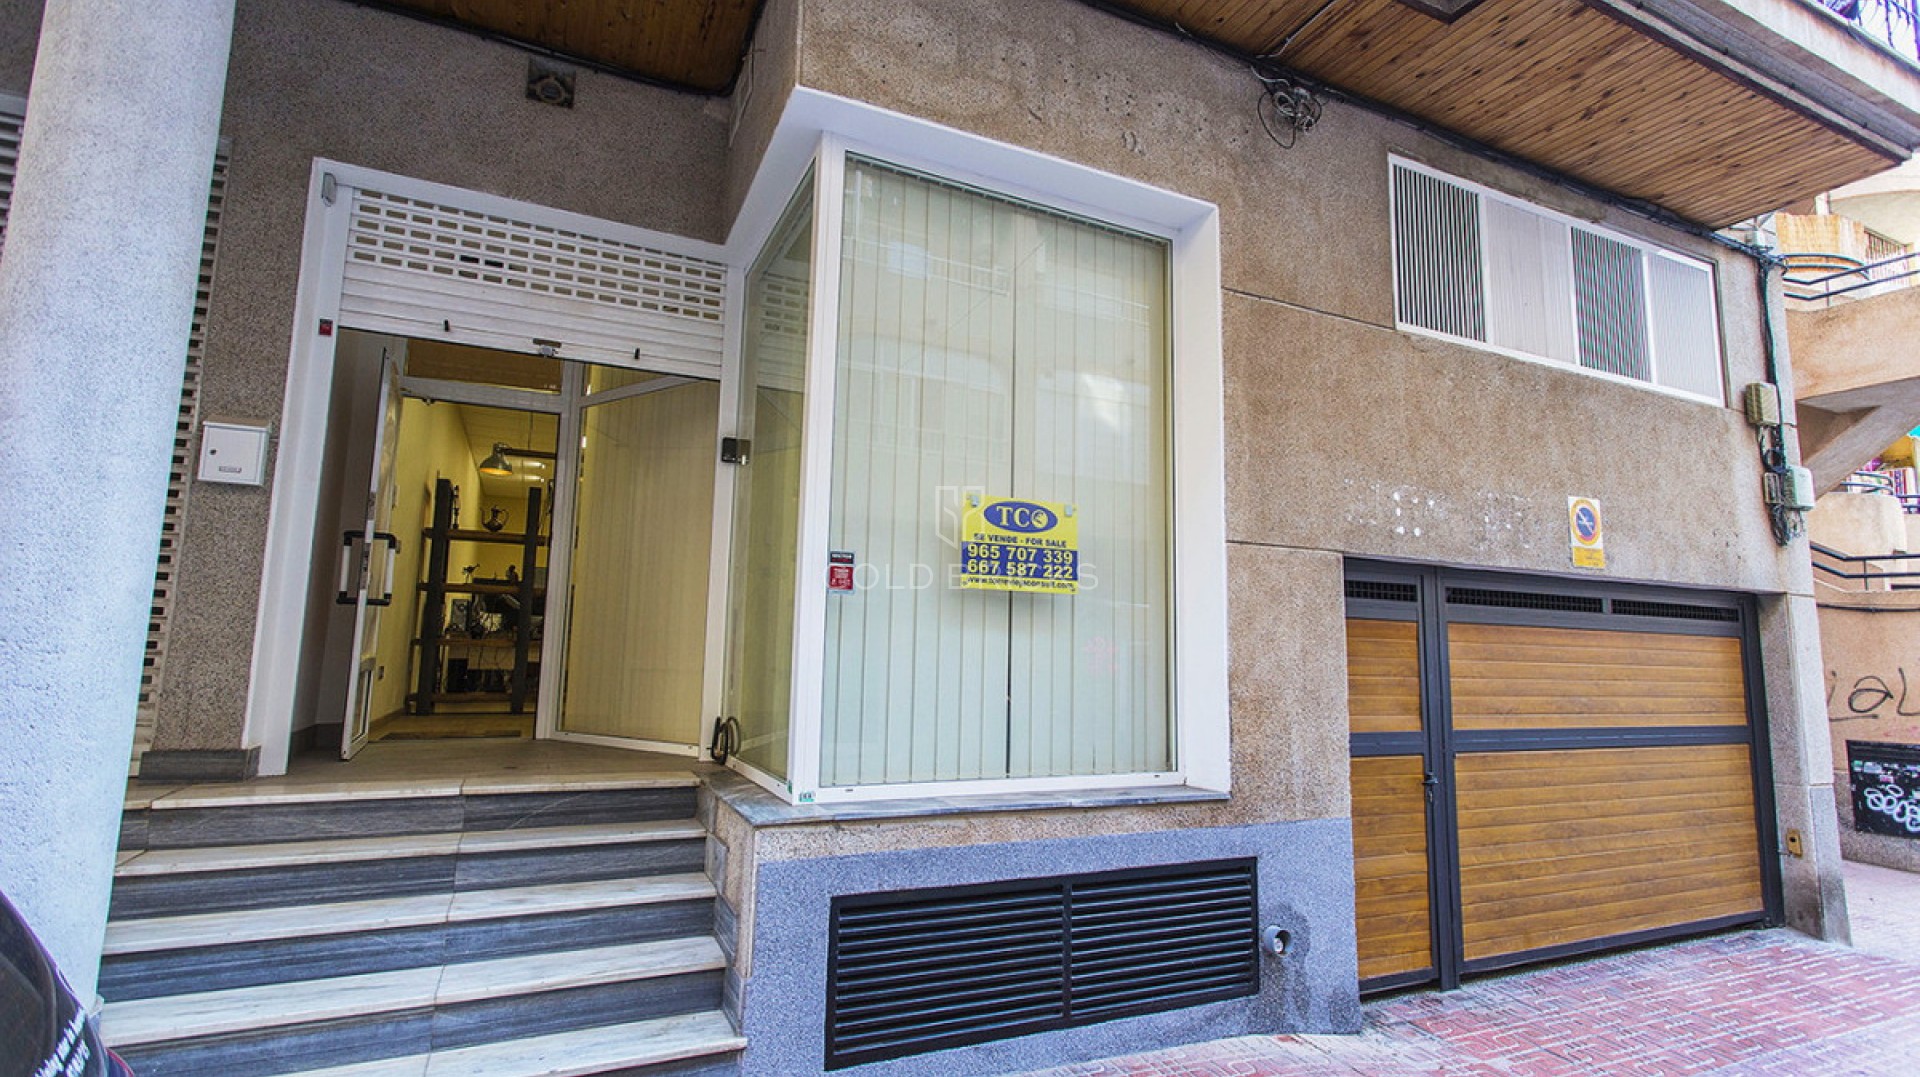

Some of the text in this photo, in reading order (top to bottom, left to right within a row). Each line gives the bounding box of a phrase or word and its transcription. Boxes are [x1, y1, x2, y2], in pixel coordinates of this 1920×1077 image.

[974, 533, 985, 541] SE
[988, 534, 1018, 544] VENDE
[1025, 537, 1043, 546] FOR
[1045, 539, 1067, 548] SALE
[967, 542, 1073, 565] 965 707 339
[967, 558, 1073, 579] 667 587 222
